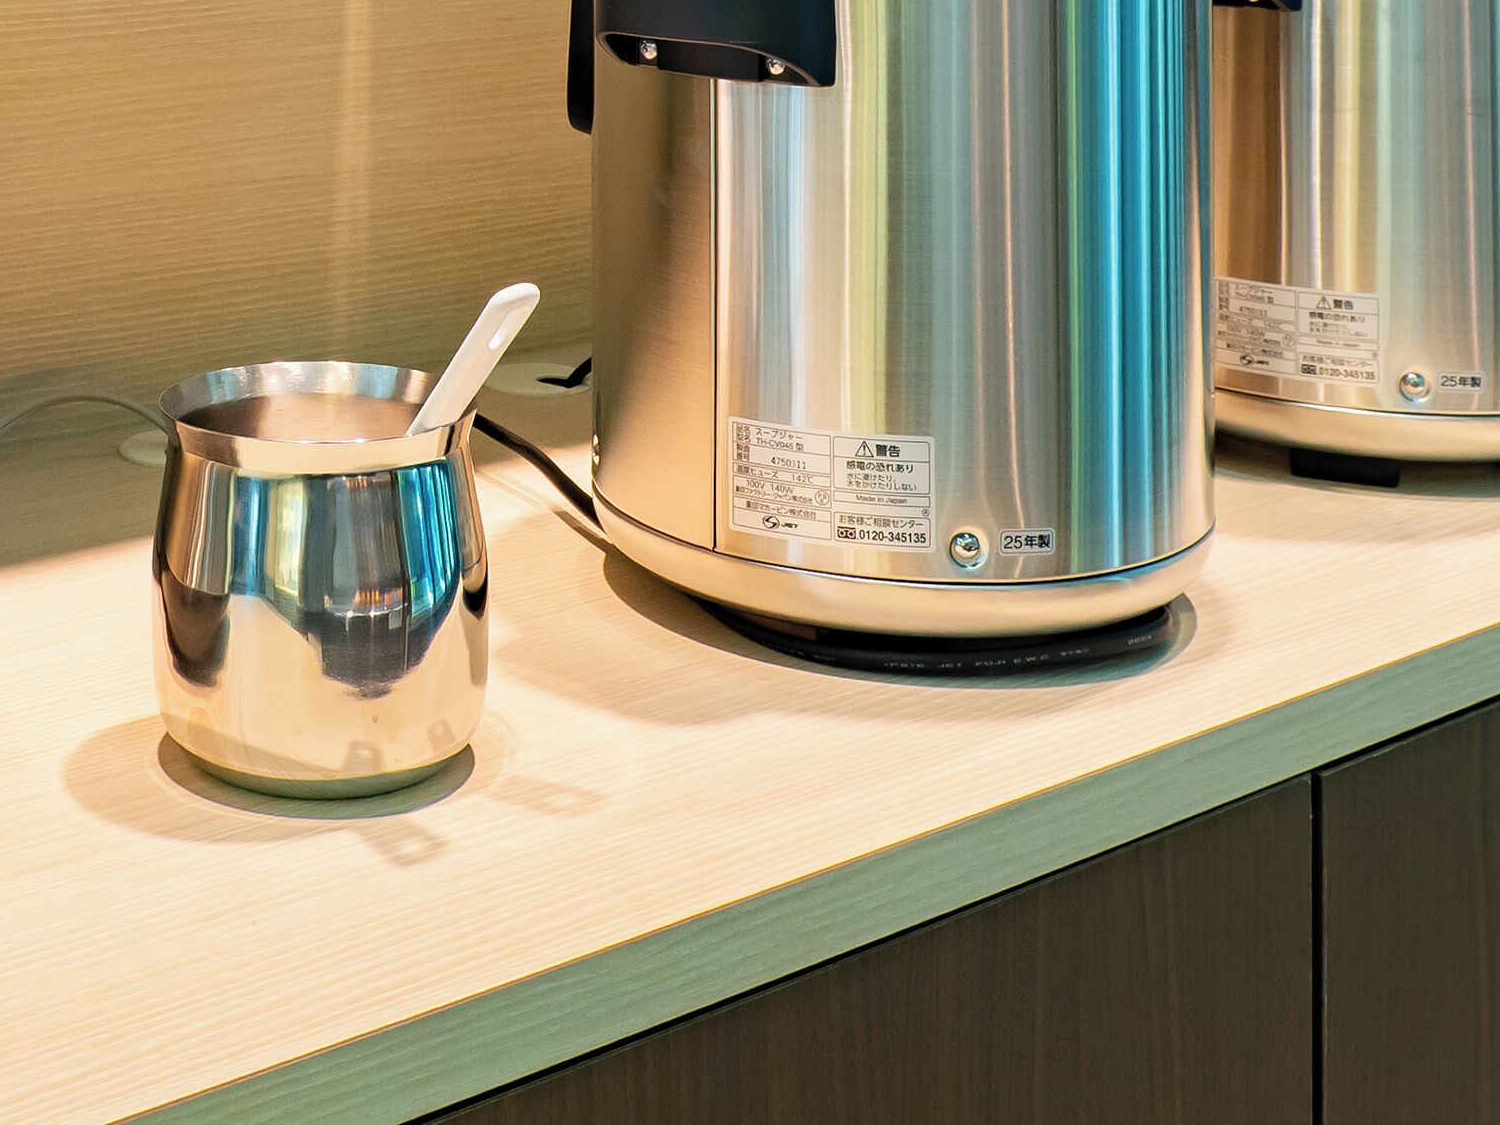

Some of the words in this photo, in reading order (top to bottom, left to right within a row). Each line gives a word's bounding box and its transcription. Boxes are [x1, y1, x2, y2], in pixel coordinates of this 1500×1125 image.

[875, 443, 901, 457] 警告
[846, 460, 914, 474] 感電の恐れあり
[838, 514, 924, 529] お客様ご相談センター
[858, 529, 927, 544] 0120-345135
[1003, 534, 1052, 550] 25年製
